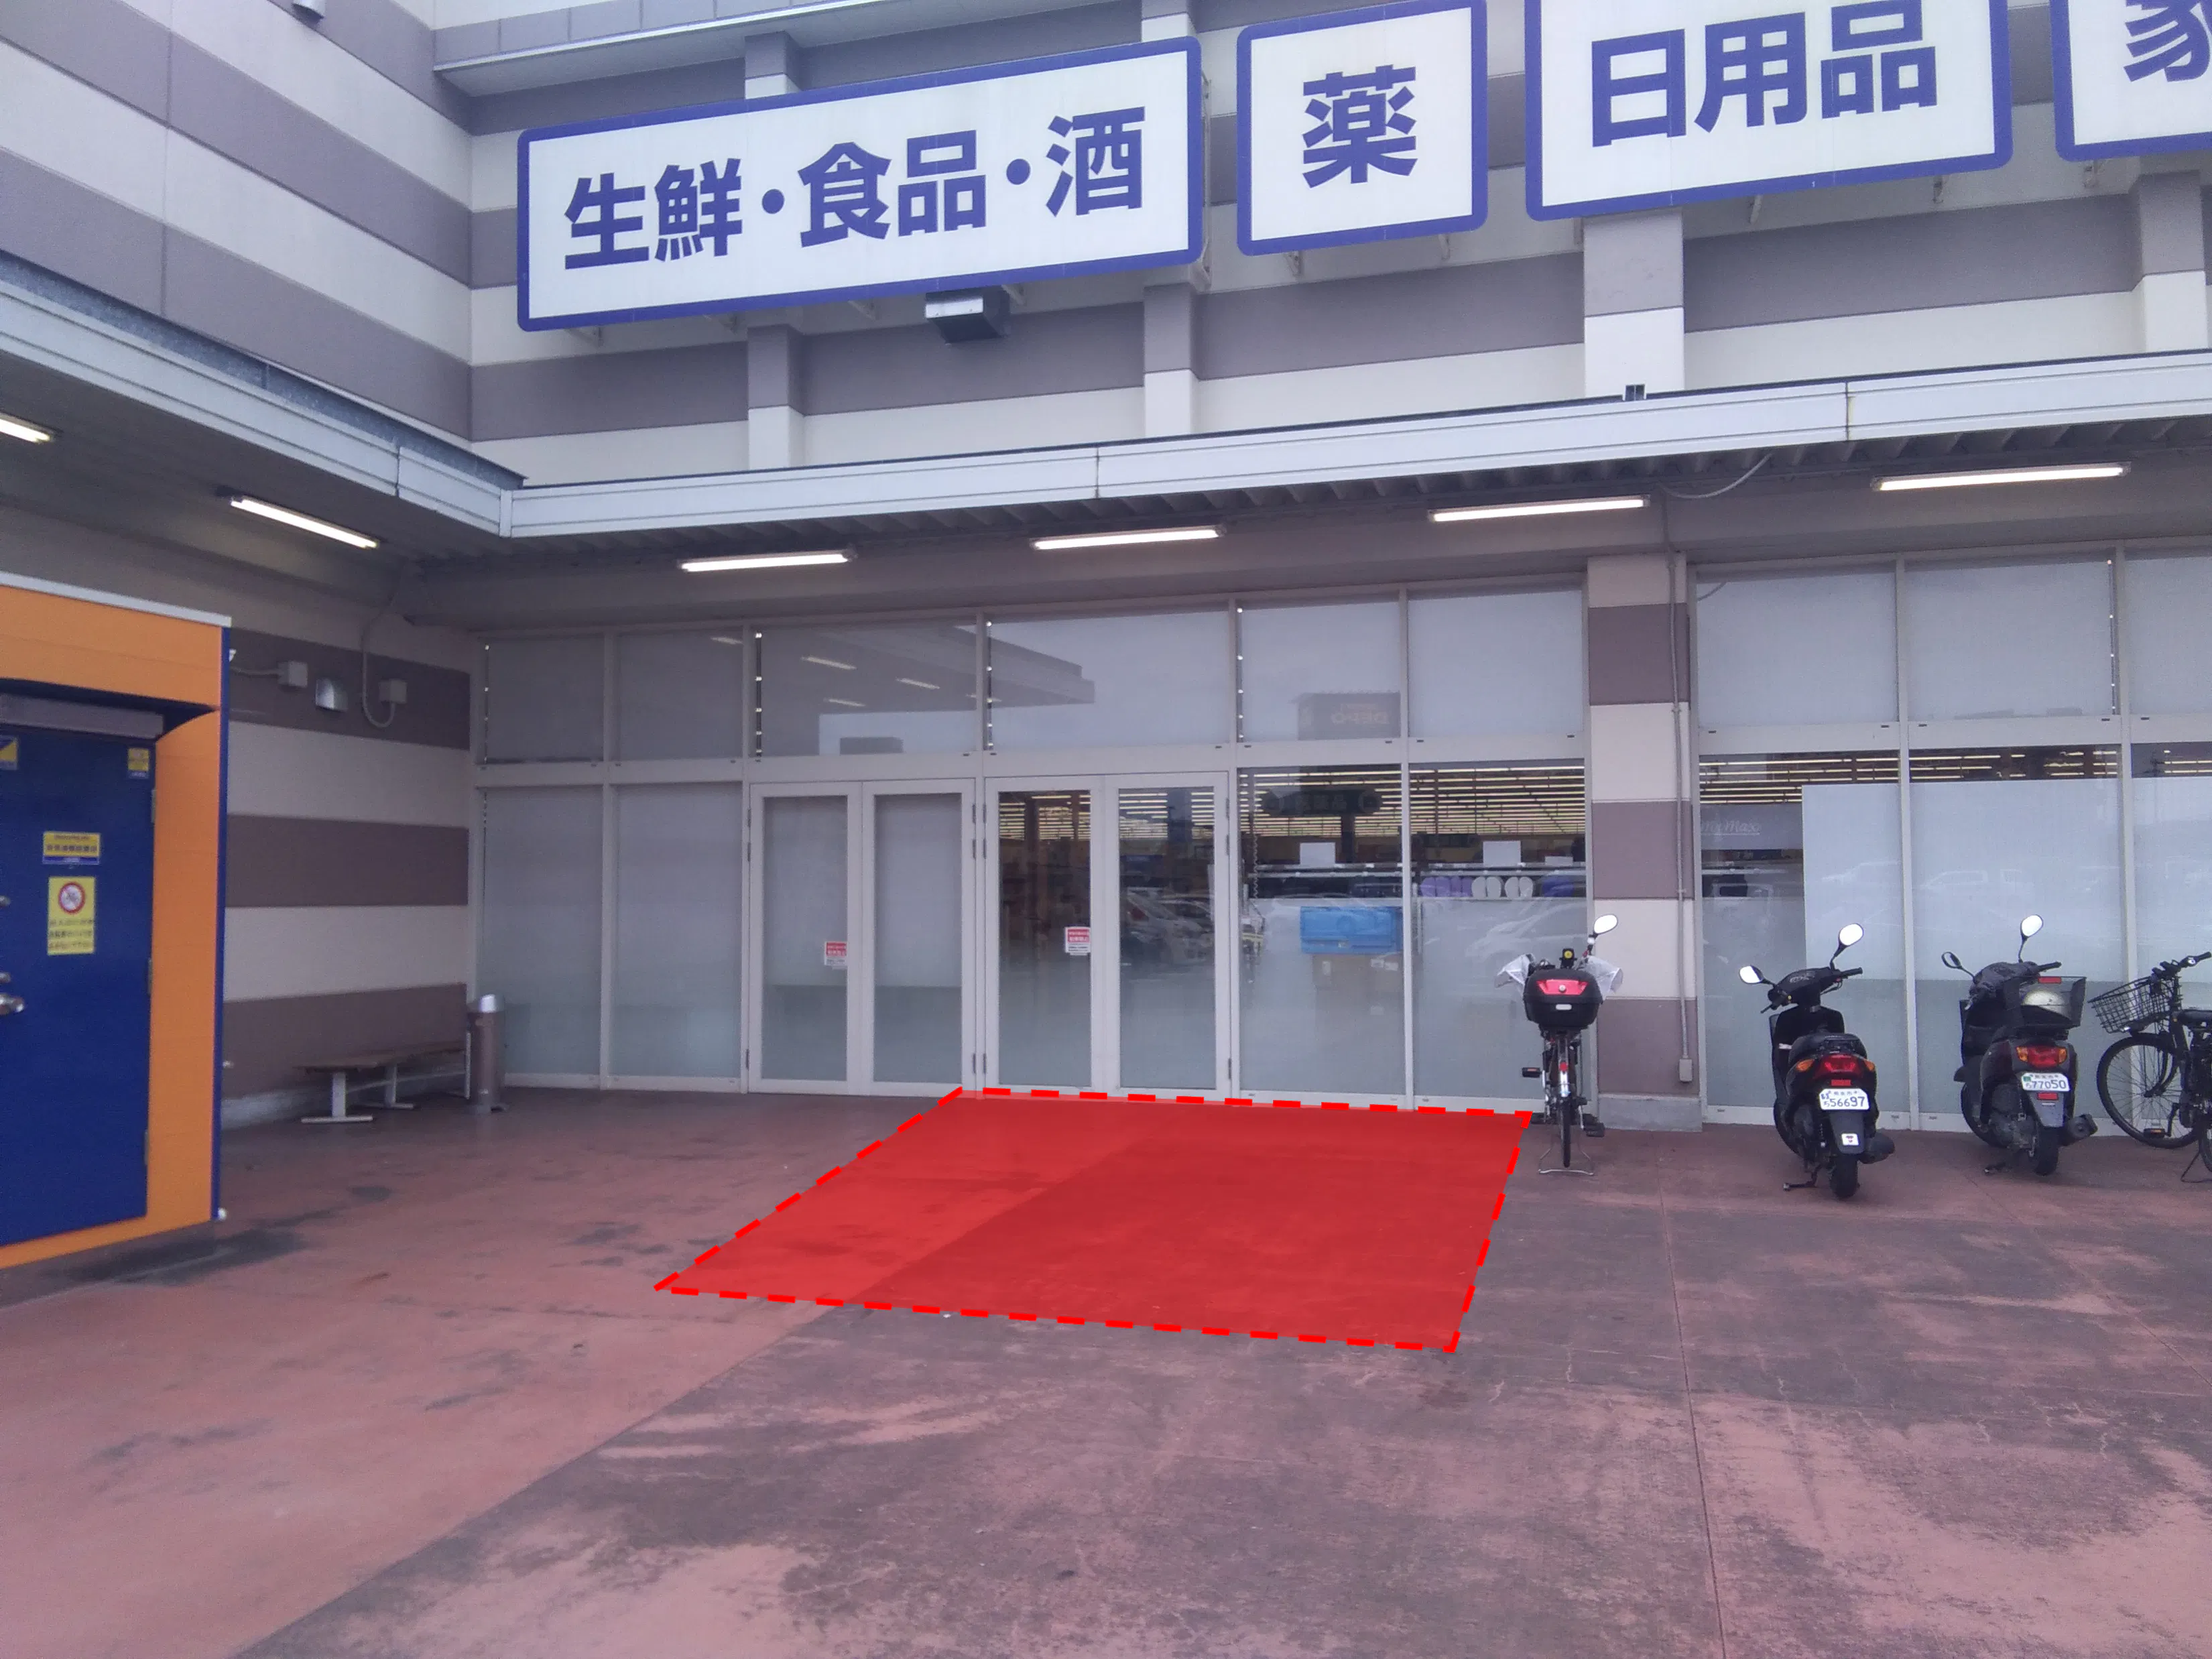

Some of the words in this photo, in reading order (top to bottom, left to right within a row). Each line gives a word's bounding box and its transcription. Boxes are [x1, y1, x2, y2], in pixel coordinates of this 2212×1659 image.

[1302, 65, 1417, 188] 薬
[1591, 0, 1938, 147] 日用品
[563, 105, 1146, 269] 生鮮・食品・酒
